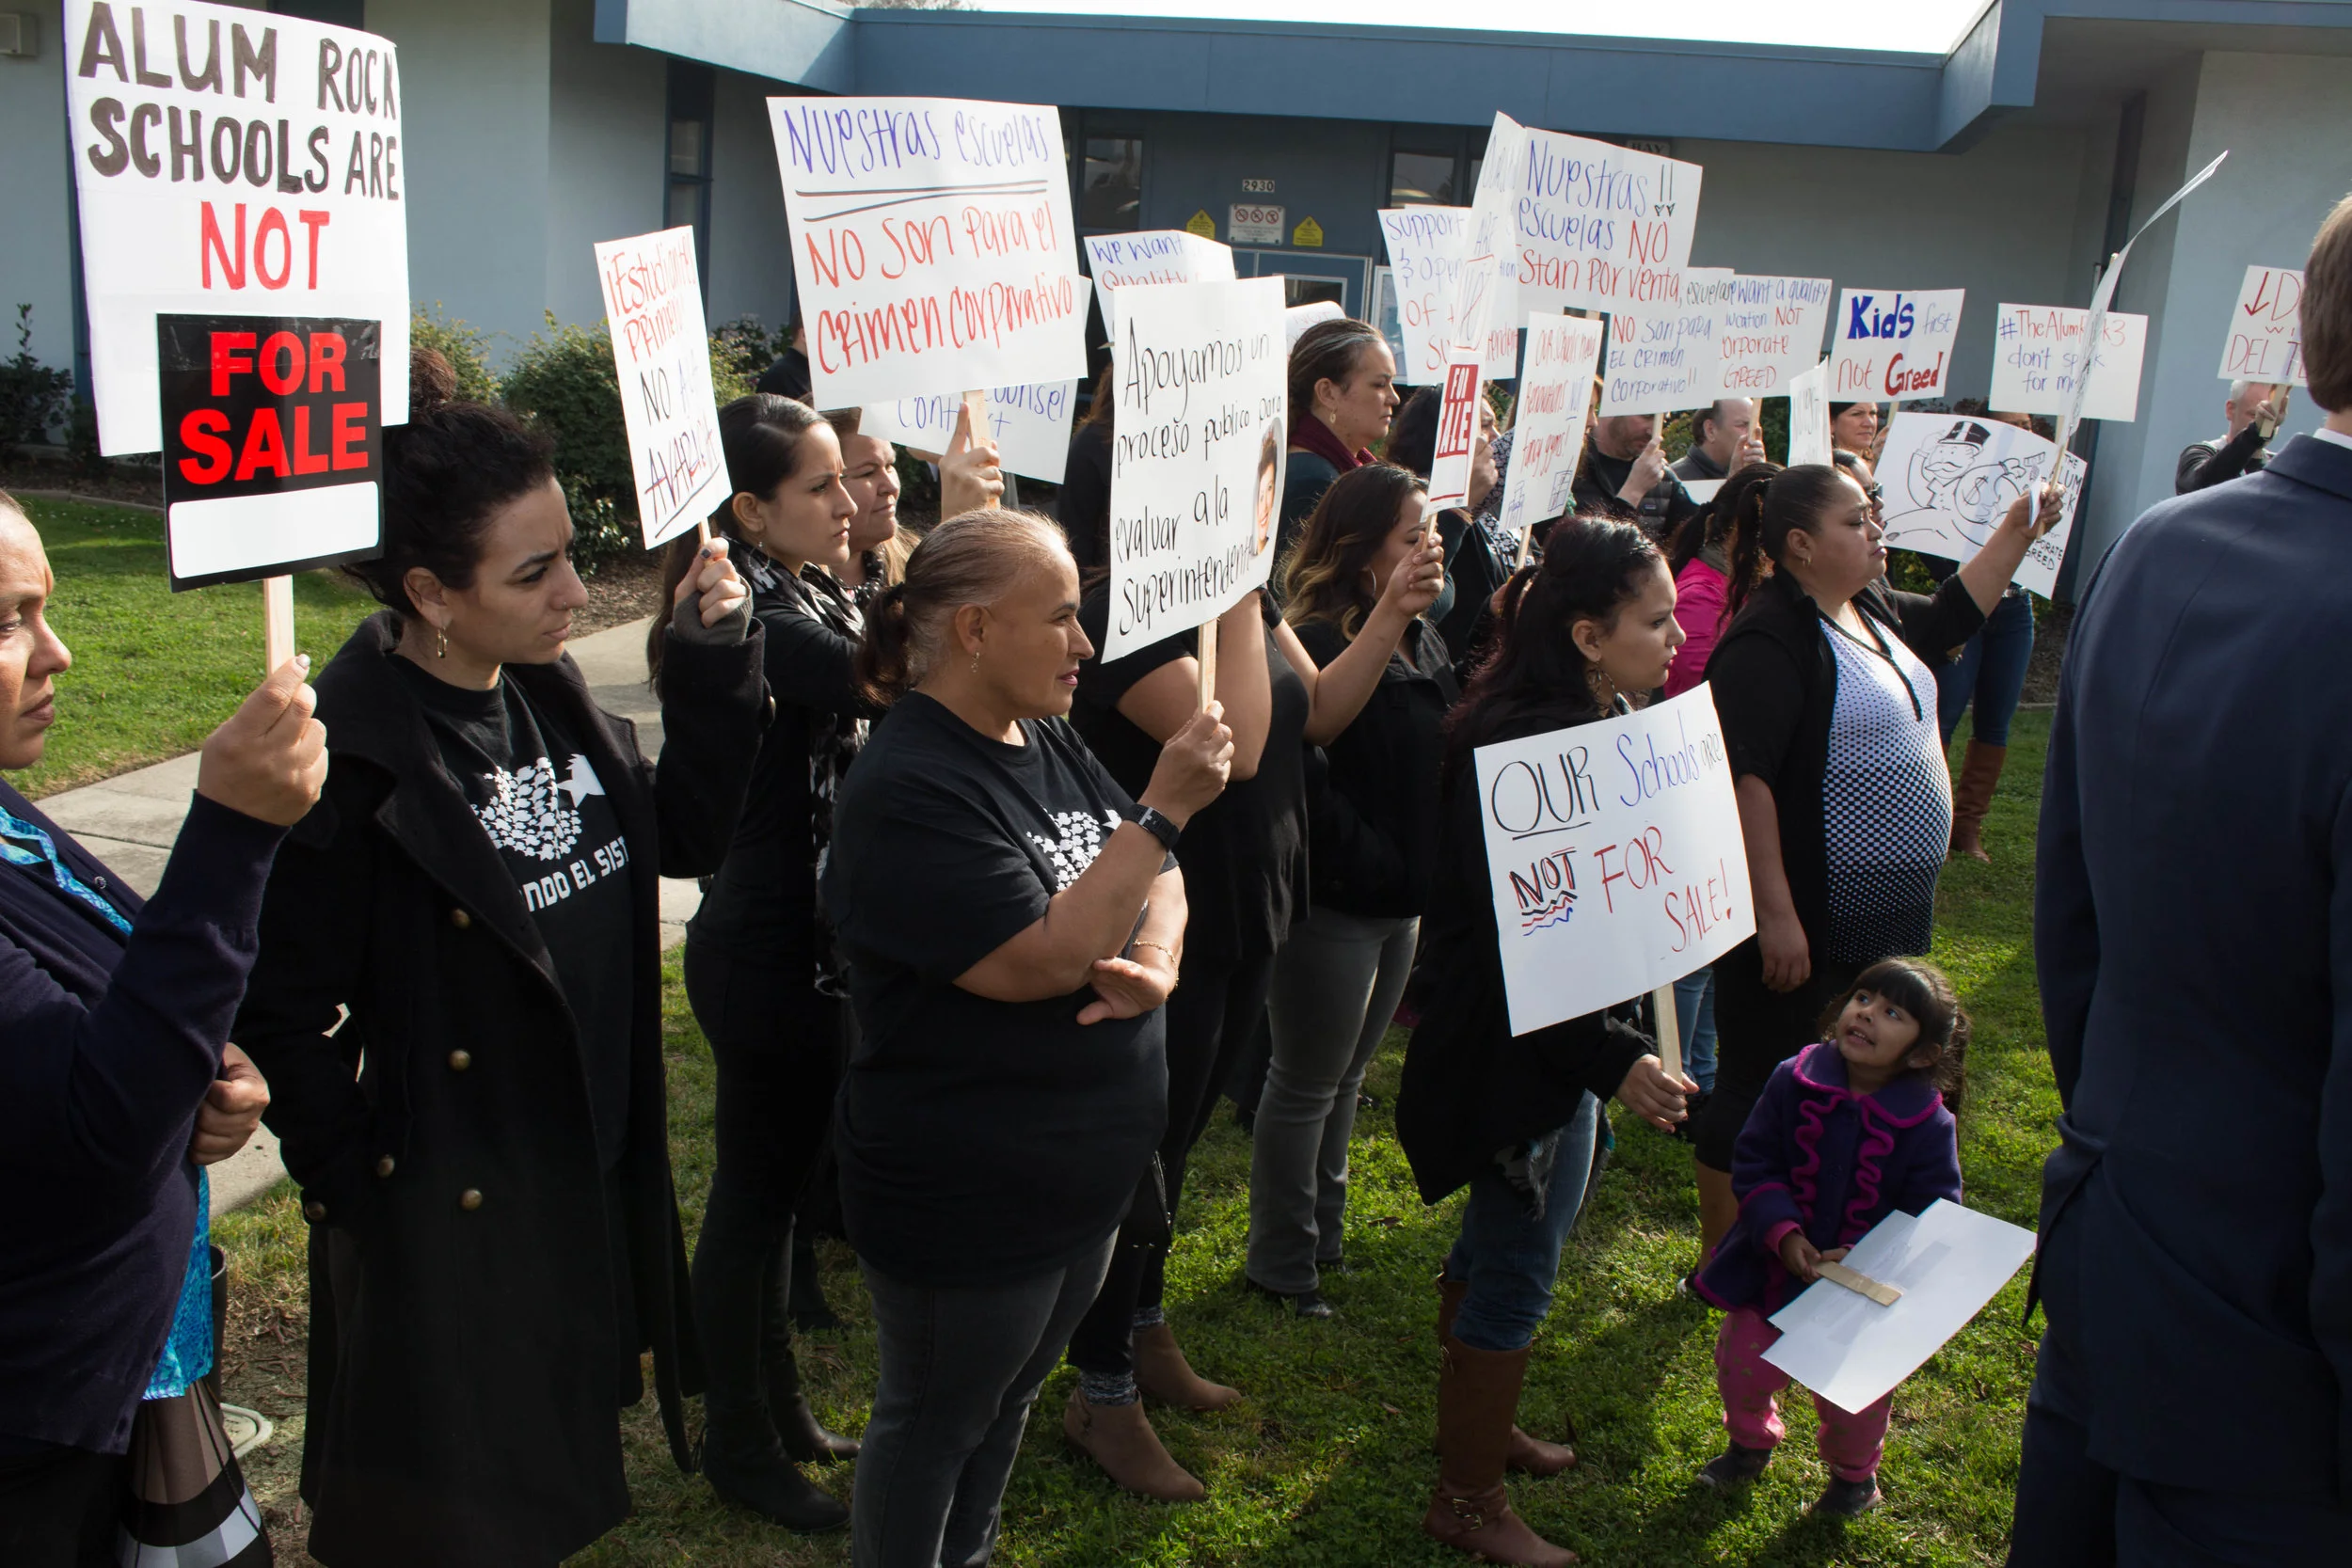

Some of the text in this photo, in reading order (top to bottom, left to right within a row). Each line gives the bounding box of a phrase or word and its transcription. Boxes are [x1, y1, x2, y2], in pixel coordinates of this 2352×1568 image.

[79, 3, 397, 120] ALUM ROCK
[87, 98, 400, 200] SCHOOLS ARE
[1243, 180, 1274, 192] 2930
[200, 200, 330, 291] NOT
[805, 229, 866, 288] NO
[1033, 200, 1057, 252] el
[1092, 240, 1124, 266] We
[1628, 220, 1668, 265] NO
[1776, 278, 1785, 301] a
[1612, 314, 1636, 344] NO
[1774, 306, 1804, 326] NOT
[1847, 293, 1953, 340] Kids first
[211, 331, 348, 398] FOR
[1124, 317, 1243, 422] Apoyamos
[1250, 333, 1270, 360] un
[1609, 349, 1627, 370] EL
[1720, 334, 1789, 361] orporate
[2008, 343, 2106, 375] don't spk
[2228, 334, 2270, 374] DEL
[640, 365, 671, 427] NO
[1723, 363, 1776, 388] GREED
[1884, 351, 1944, 397] Greed
[2022, 371, 2047, 393] for
[179, 402, 370, 485] SALE
[1117, 419, 1190, 478] proceso
[1204, 404, 1250, 461] publico
[1491, 745, 1599, 833] OUR
[1616, 709, 1699, 808] Schools
[520, 835, 629, 913] NDO EL SIST
[1509, 826, 1674, 914] NOT FOR
[1664, 857, 1732, 954] SALE!
